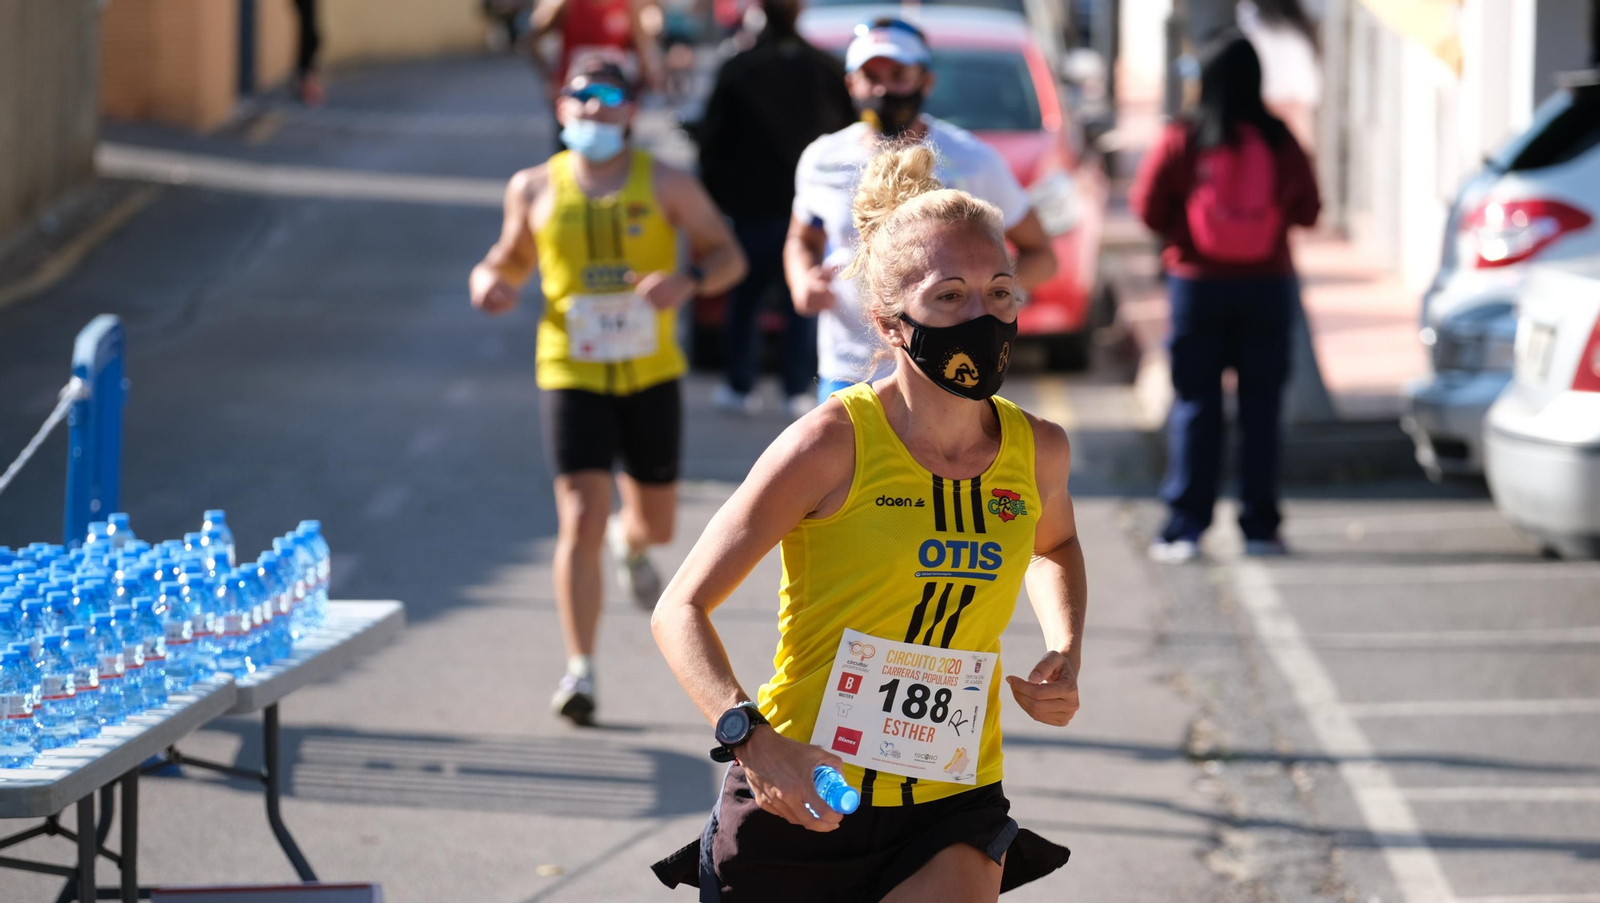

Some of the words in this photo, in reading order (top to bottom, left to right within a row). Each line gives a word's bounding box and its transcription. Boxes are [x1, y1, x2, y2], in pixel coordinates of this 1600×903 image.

[875, 495, 912, 507] daen
[918, 539, 1003, 570] OTIS
[886, 649, 937, 672] CIRCUITO
[845, 676, 855, 690] B
[881, 665, 921, 681] CARRERAS
[921, 672, 959, 687] POPULARES
[878, 678, 953, 724] 188
[882, 717, 936, 743] ESTHER
[948, 709, 969, 737] R
